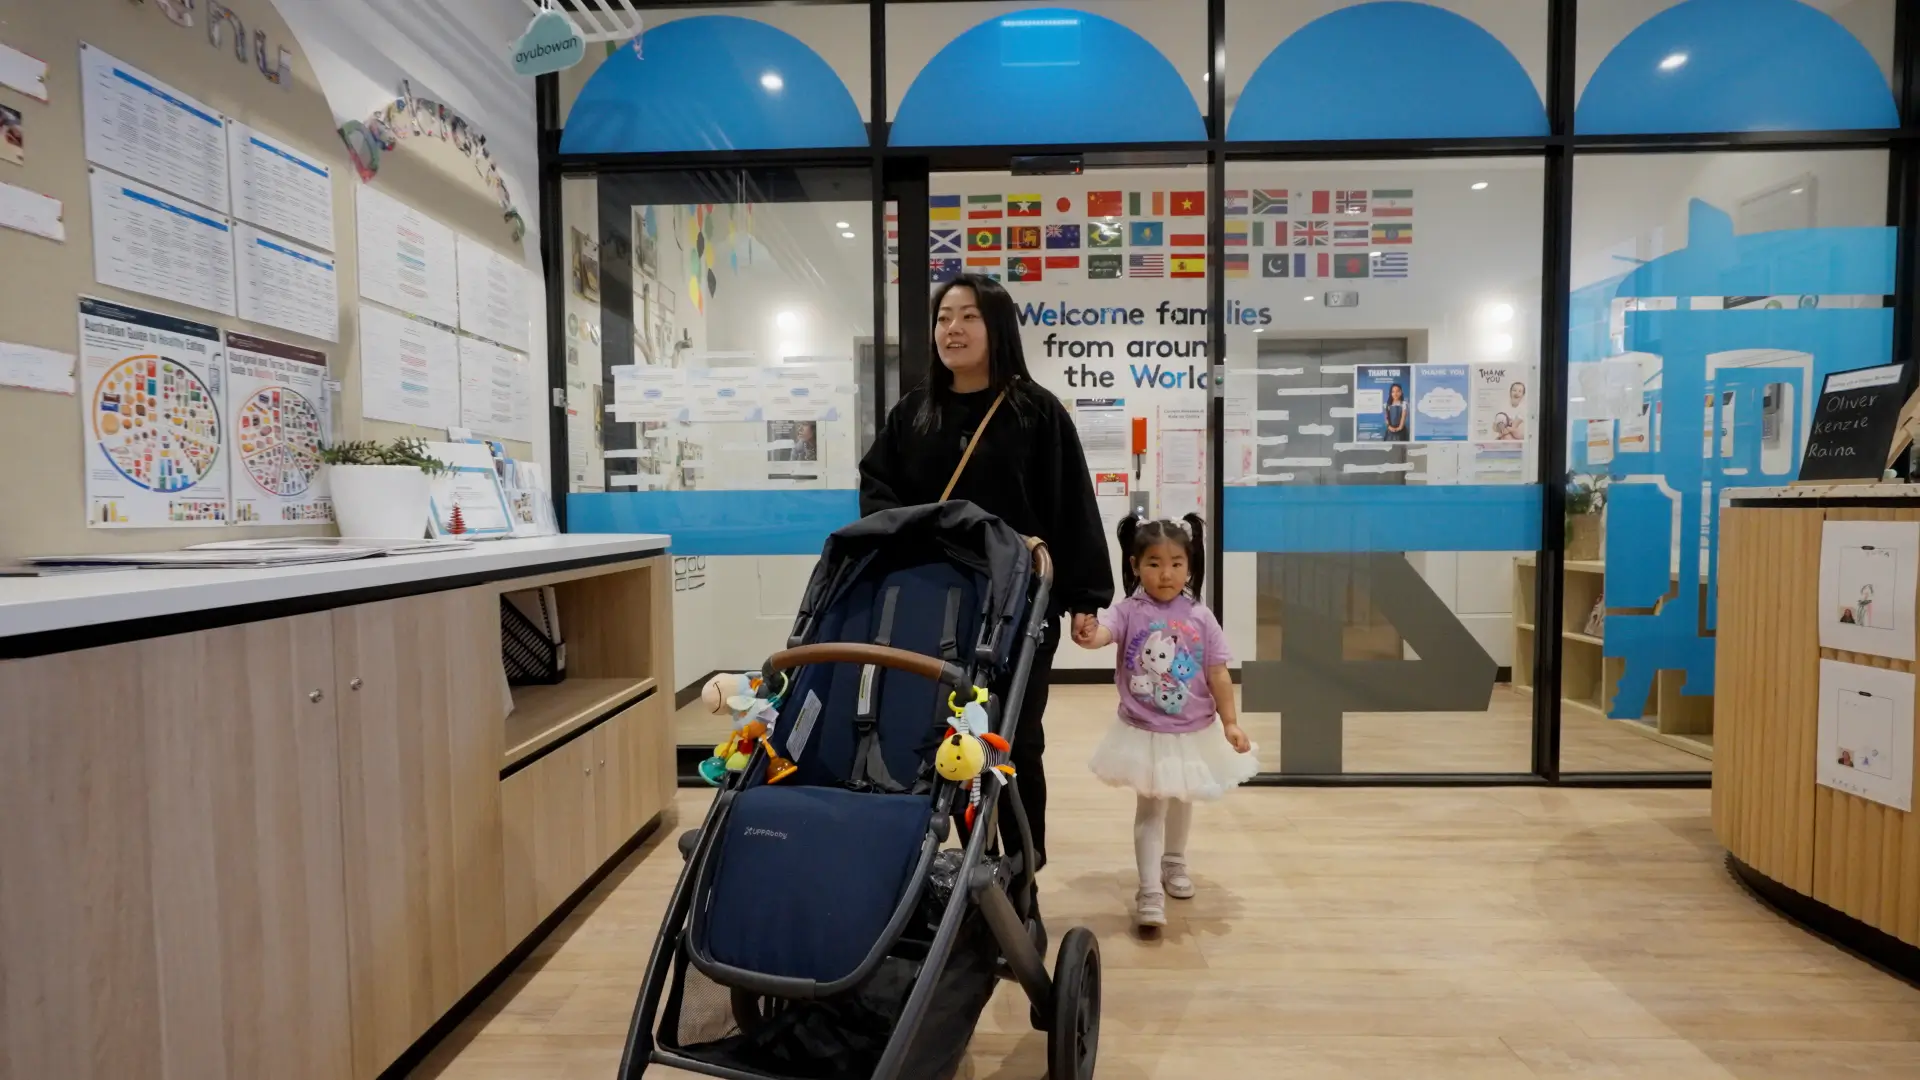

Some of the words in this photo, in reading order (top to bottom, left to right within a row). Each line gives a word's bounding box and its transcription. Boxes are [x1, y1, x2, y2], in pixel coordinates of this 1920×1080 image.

[515, 37, 577, 64] ayubowan
[1014, 301, 1145, 326] Welcome
[1156, 300, 1272, 325] famlies
[1043, 333, 1114, 358] from
[1126, 333, 1227, 358] aroun
[1064, 363, 1115, 388] the
[1368, 369, 1388, 377] THANK
[1389, 369, 1400, 377] YOU
[1479, 369, 1506, 378] THANK
[1827, 395, 1877, 412] Oliver
[1808, 441, 1856, 457] Raina
